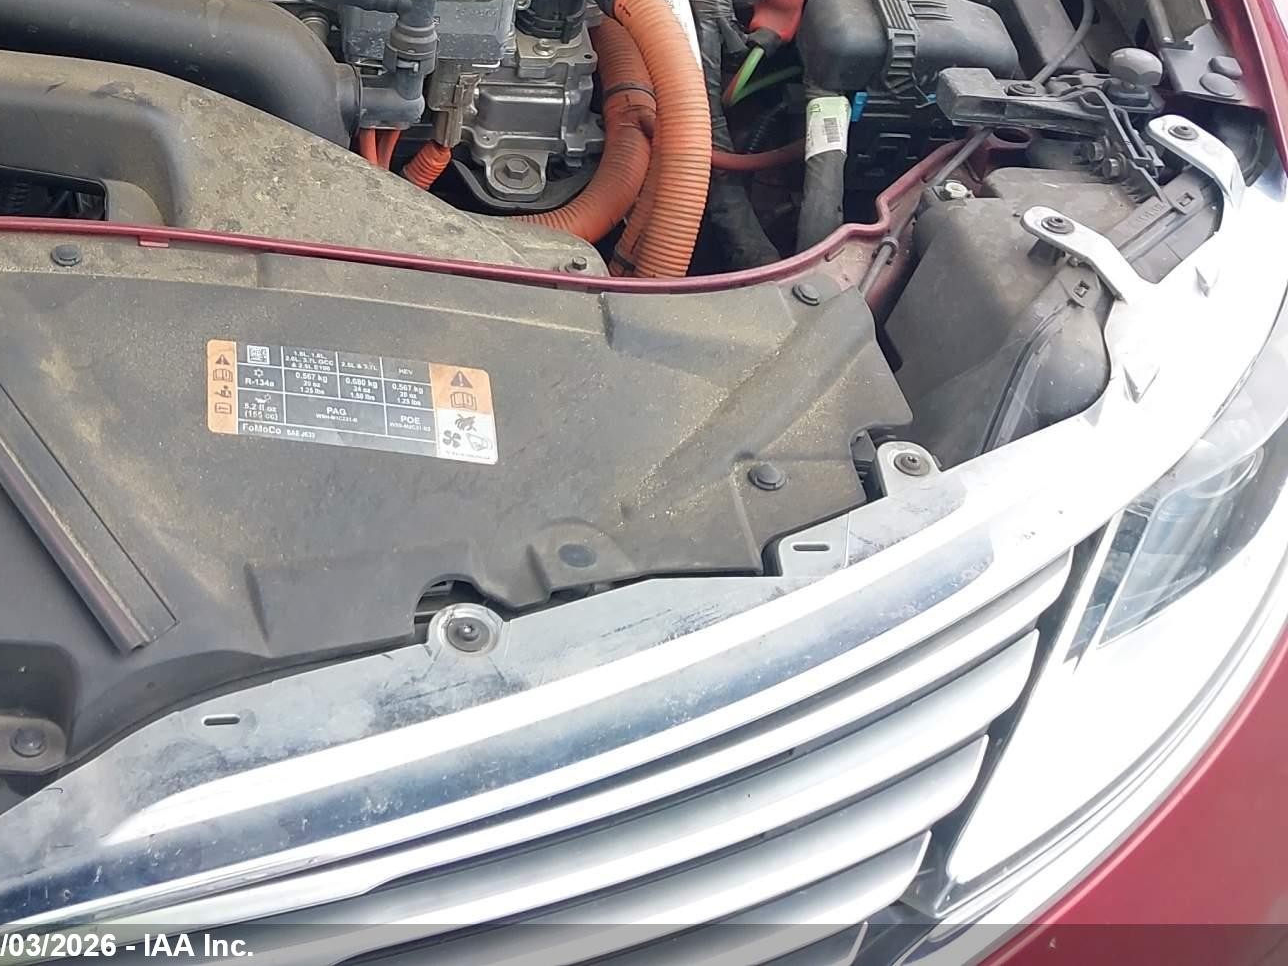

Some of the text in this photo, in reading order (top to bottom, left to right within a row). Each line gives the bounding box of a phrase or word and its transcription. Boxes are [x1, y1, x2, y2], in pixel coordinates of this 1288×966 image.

[245, 378, 275, 387] R-134a
[317, 374, 328, 384] kg
[367, 379, 378, 389] kg
[326, 406, 347, 416] PAG
[400, 415, 421, 425] POE
[243, 423, 281, 435] FoMoCo
